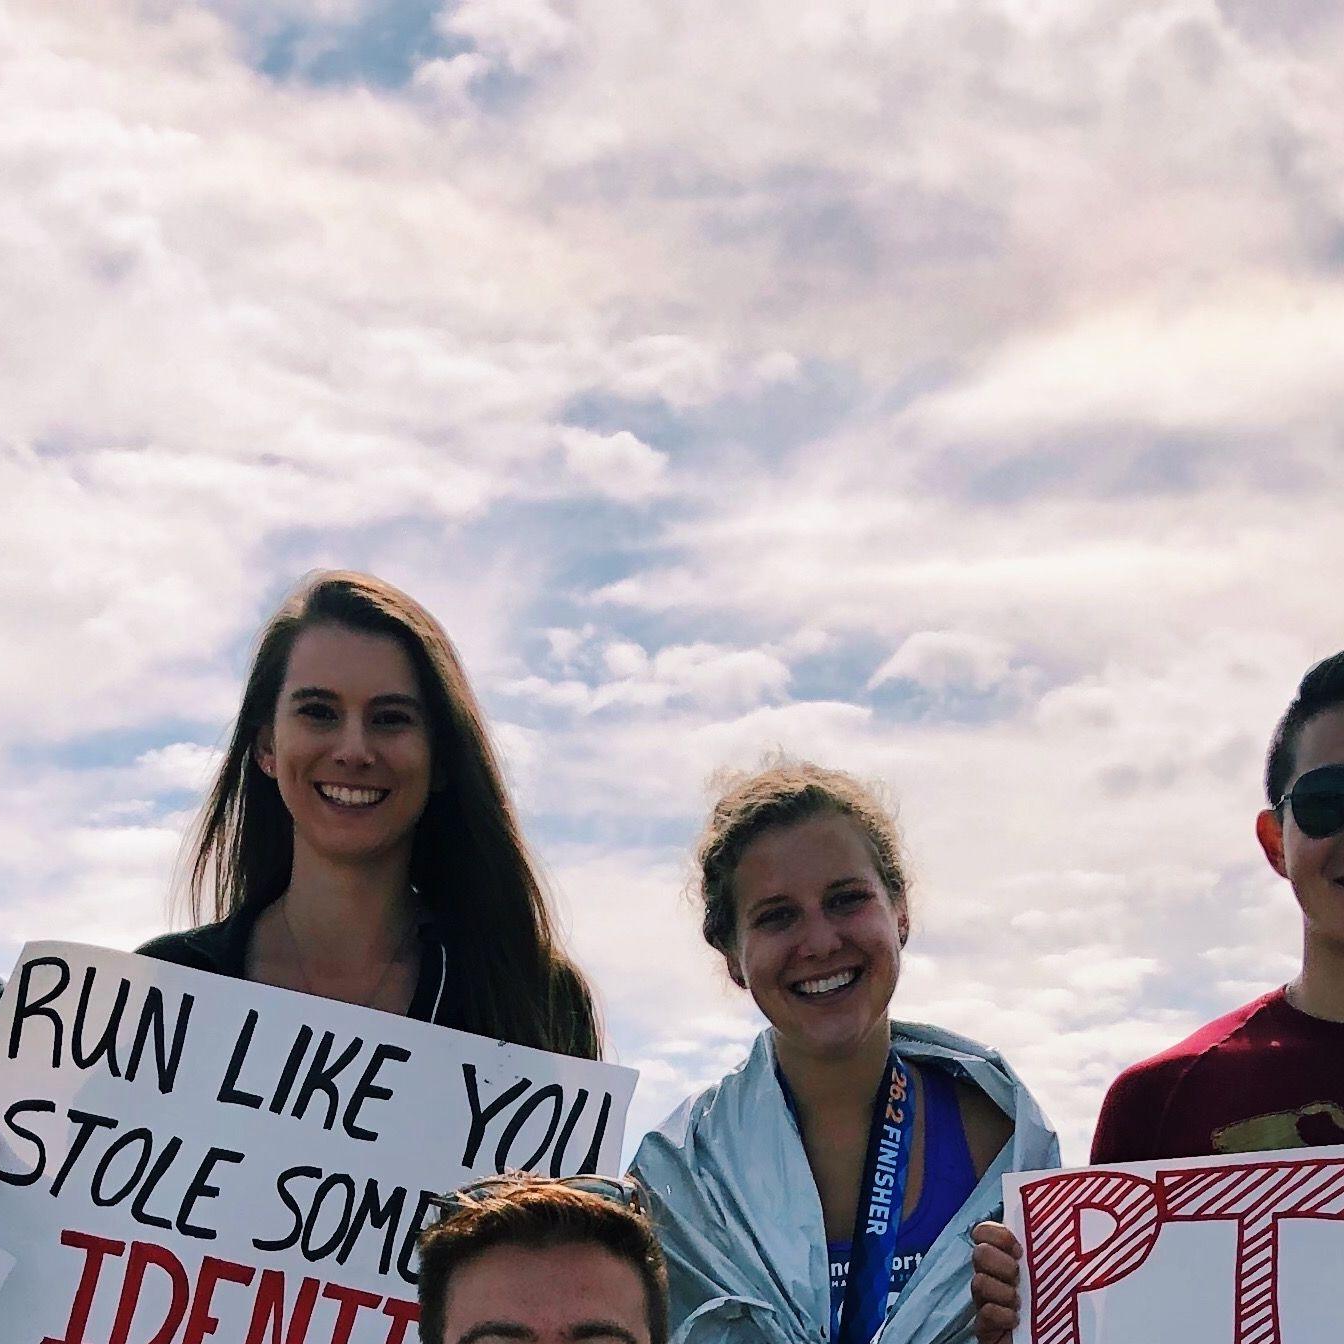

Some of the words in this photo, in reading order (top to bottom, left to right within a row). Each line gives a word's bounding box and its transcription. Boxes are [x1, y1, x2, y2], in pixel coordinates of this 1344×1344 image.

[7, 956, 194, 1094] RUN
[216, 1009, 411, 1141] LIKE
[461, 1062, 613, 1176] YOU
[884, 1066, 908, 1125] 26.2
[865, 1123, 902, 1236] FINISHER
